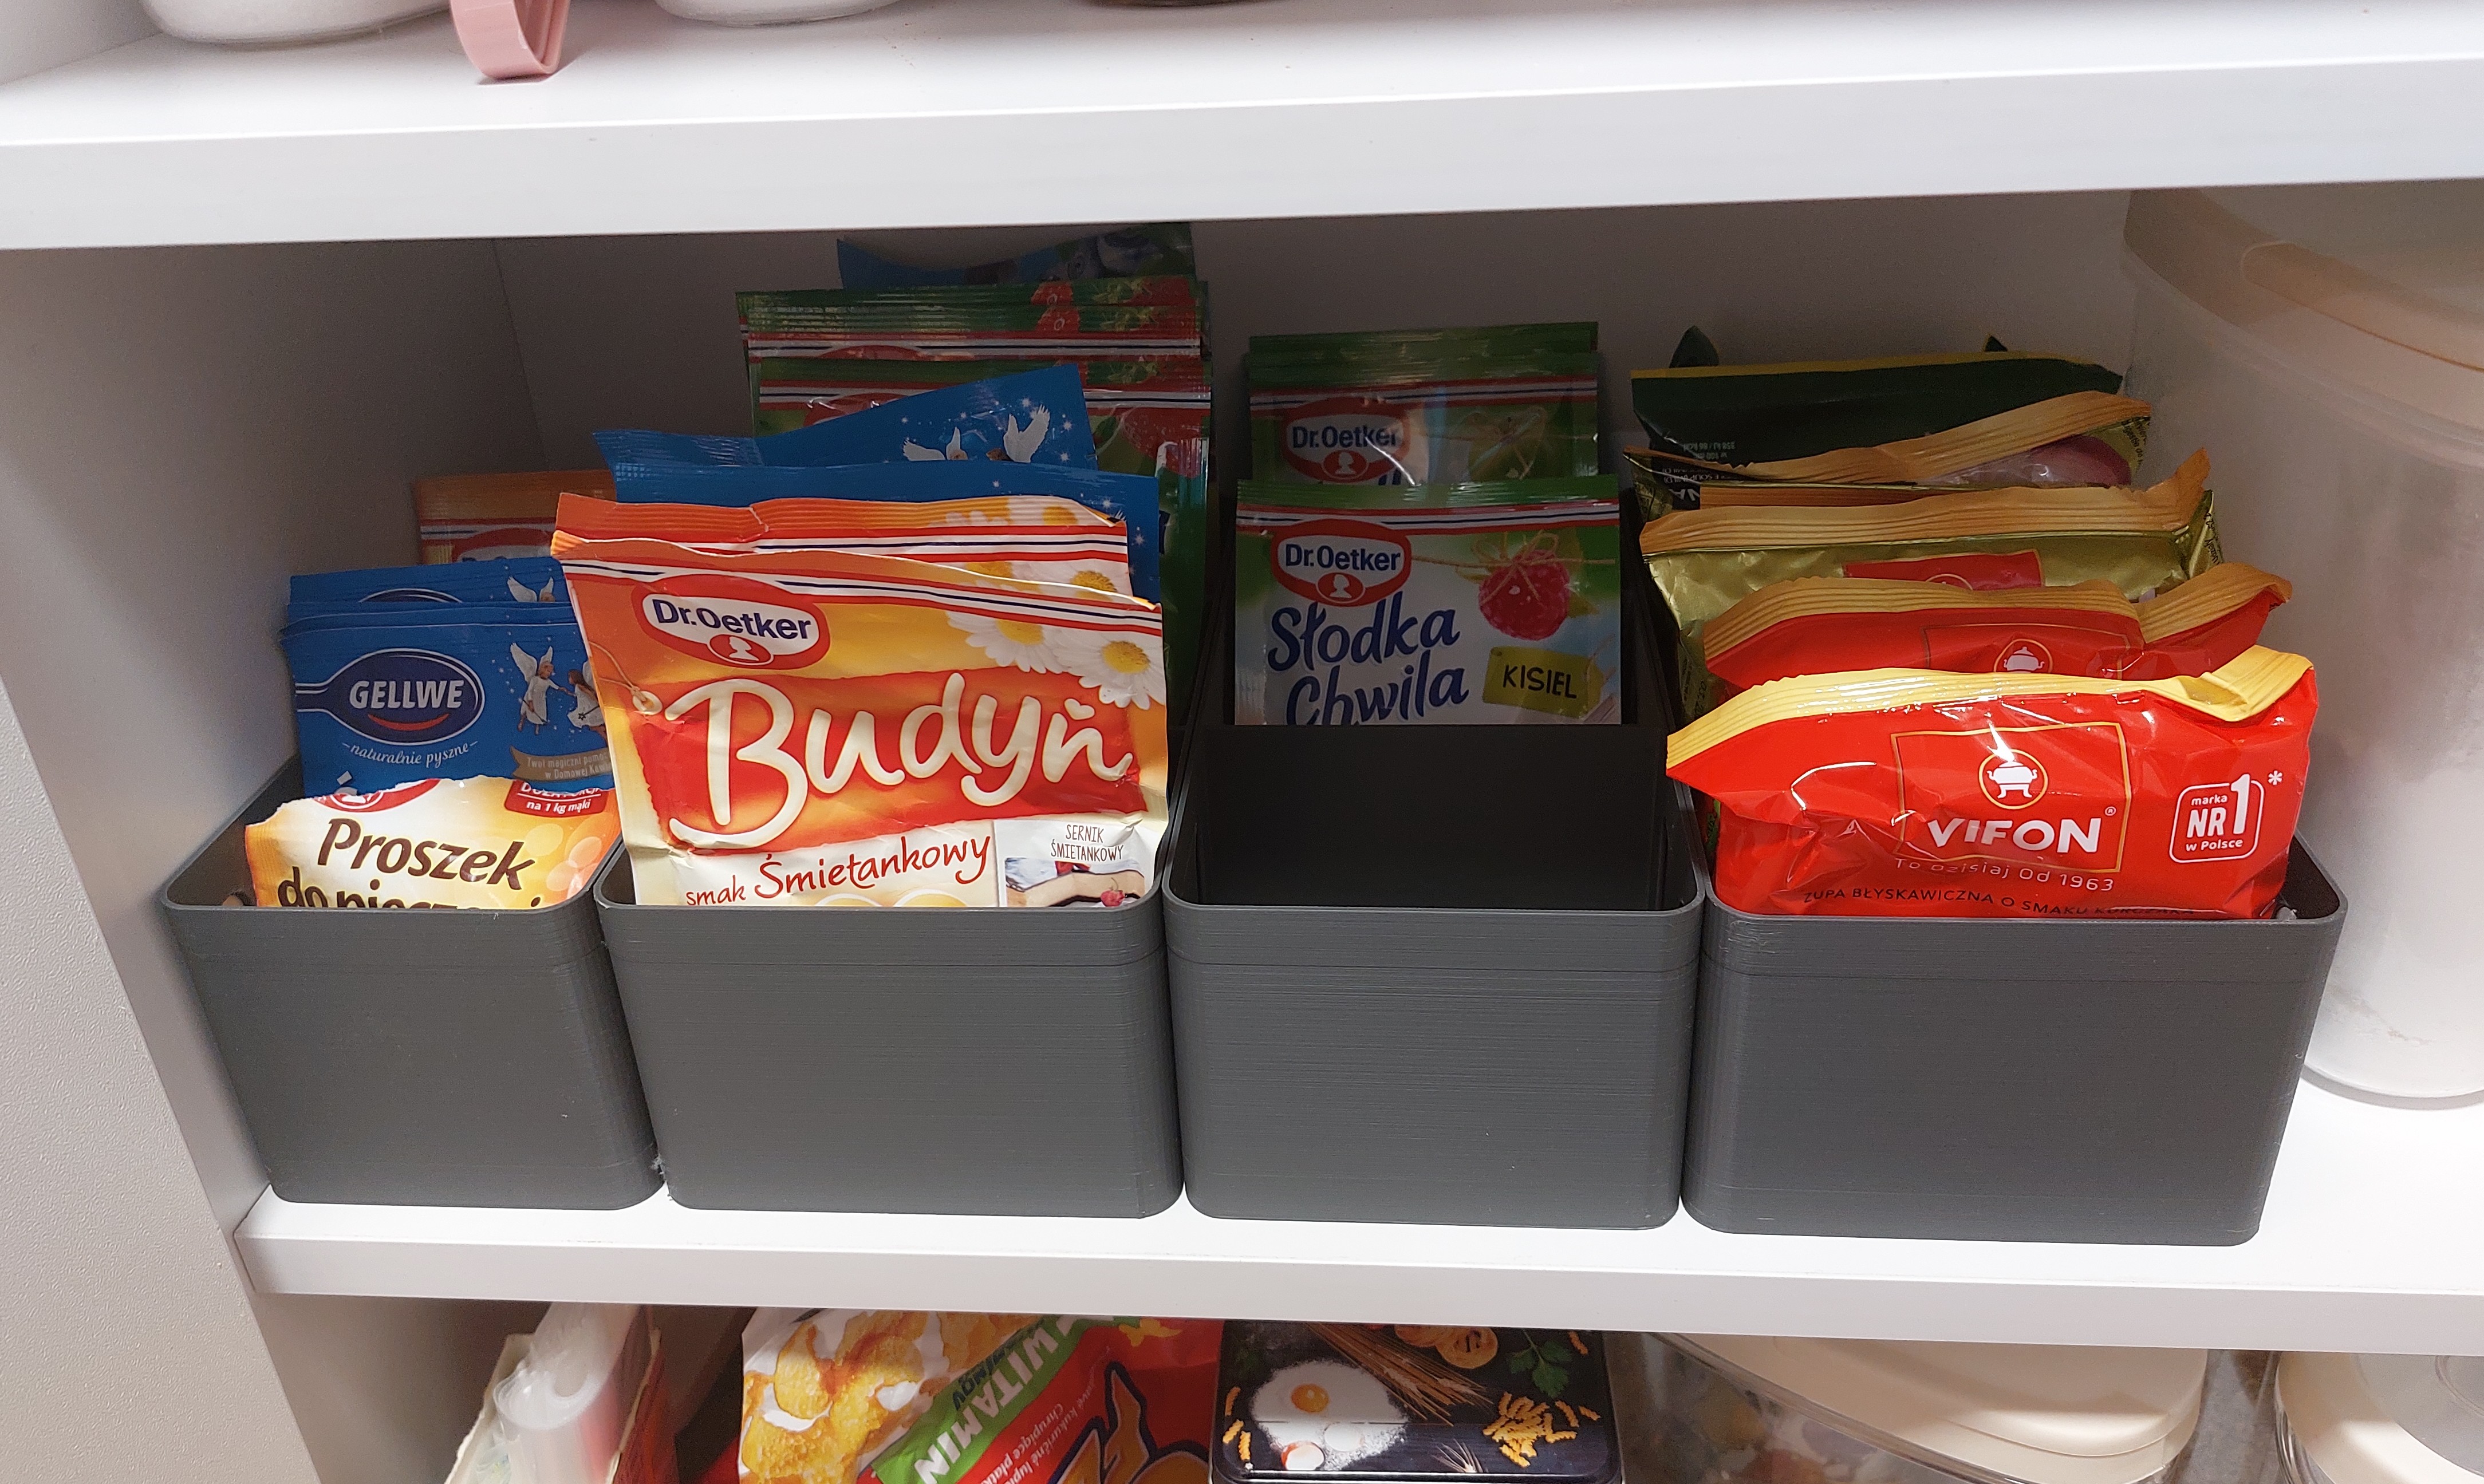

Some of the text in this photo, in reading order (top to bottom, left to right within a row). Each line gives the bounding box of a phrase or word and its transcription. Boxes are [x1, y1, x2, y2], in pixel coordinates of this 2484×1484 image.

[1267, 591, 1461, 672] Słodka
[349, 680, 464, 709] GELLWE
[1286, 650, 1469, 725] Chwila
[1503, 665, 1578, 698] KISIEL
[350, 743, 469, 768] naturalnie pyszne
[664, 672, 1133, 849] Budyń
[526, 799, 592, 814] na 1 kg mąki
[2191, 794, 2228, 806] marka
[1065, 824, 1104, 843] SERNIK
[1927, 818, 2101, 853] VIFON
[2186, 807, 2227, 838] NR
[317, 818, 536, 890] Proszek
[1051, 838, 1124, 862] ŚMIETANKOWY
[2185, 839, 2244, 851] w Polsce
[685, 835, 991, 906] smak Śmietankowy
[1895, 858, 1921, 869] To
[2018, 868, 2051, 883] Od
[2060, 874, 2114, 891] 1963
[1803, 889, 1846, 904] ZUPA
[1852, 887, 1994, 905] BŁYSKAWICZNA
[2001, 895, 2016, 908] O
[2021, 900, 2088, 915] SMAKU
[914, 1327, 1059, 1484] WITAMIN
